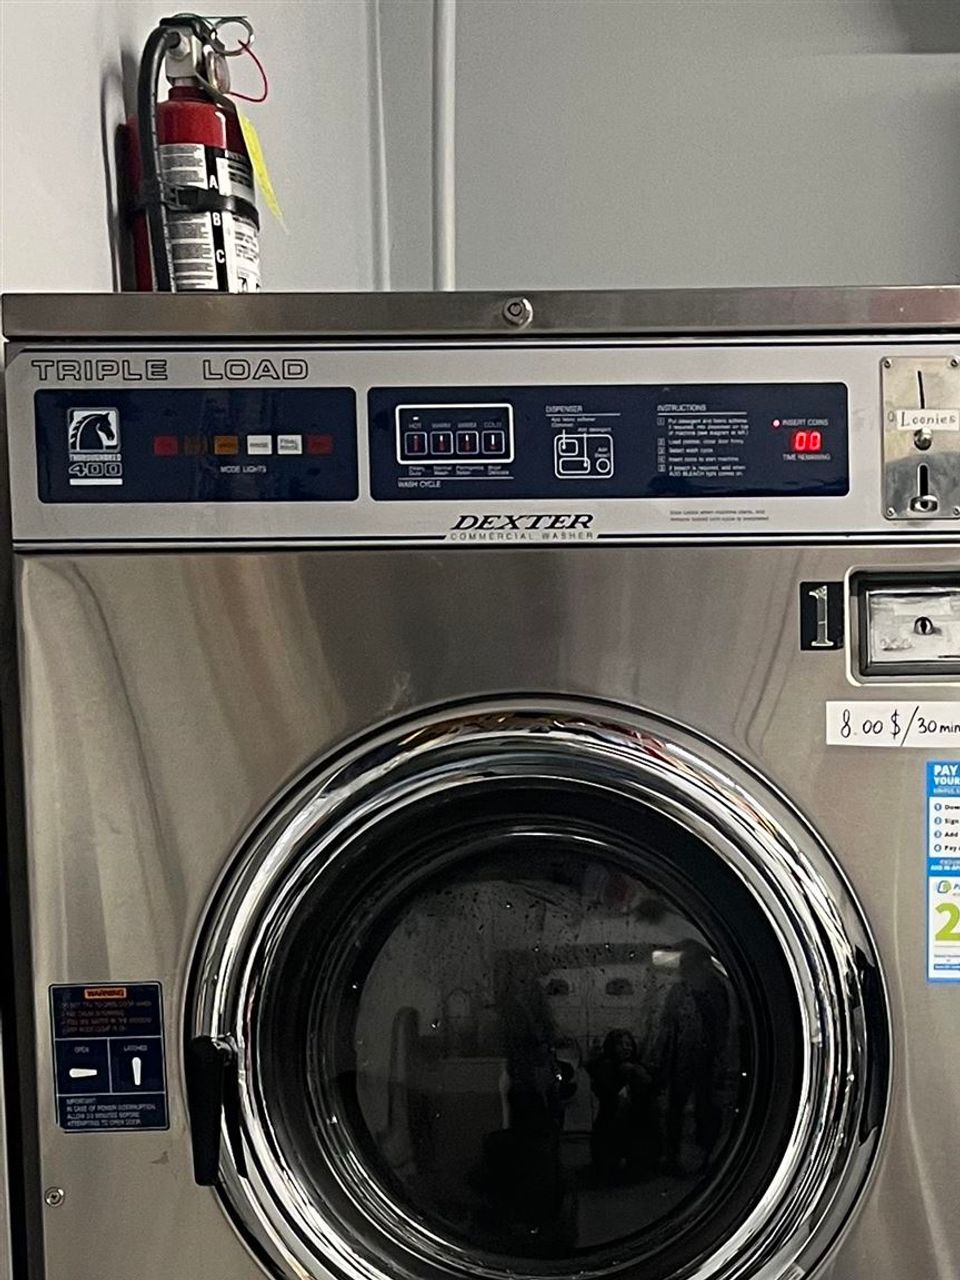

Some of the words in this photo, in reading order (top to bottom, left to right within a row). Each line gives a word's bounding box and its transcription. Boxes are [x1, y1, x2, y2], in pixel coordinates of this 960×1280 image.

[208, 175, 218, 189] A
[212, 212, 221, 226] B
[216, 249, 225, 263] C
[31, 359, 168, 381] TRIPLE
[203, 358, 308, 380] LOAD
[901, 411, 957, 427] Loonies
[795, 431, 821, 451] 00
[68, 462, 123, 477] 400
[450, 514, 594, 531] DEXTER
[450, 532, 534, 541] COMMERCIAL
[542, 531, 594, 540] WASHER
[809, 585, 834, 646] 1
[934, 765, 958, 776] PAY
[934, 776, 960, 785] YOUR
